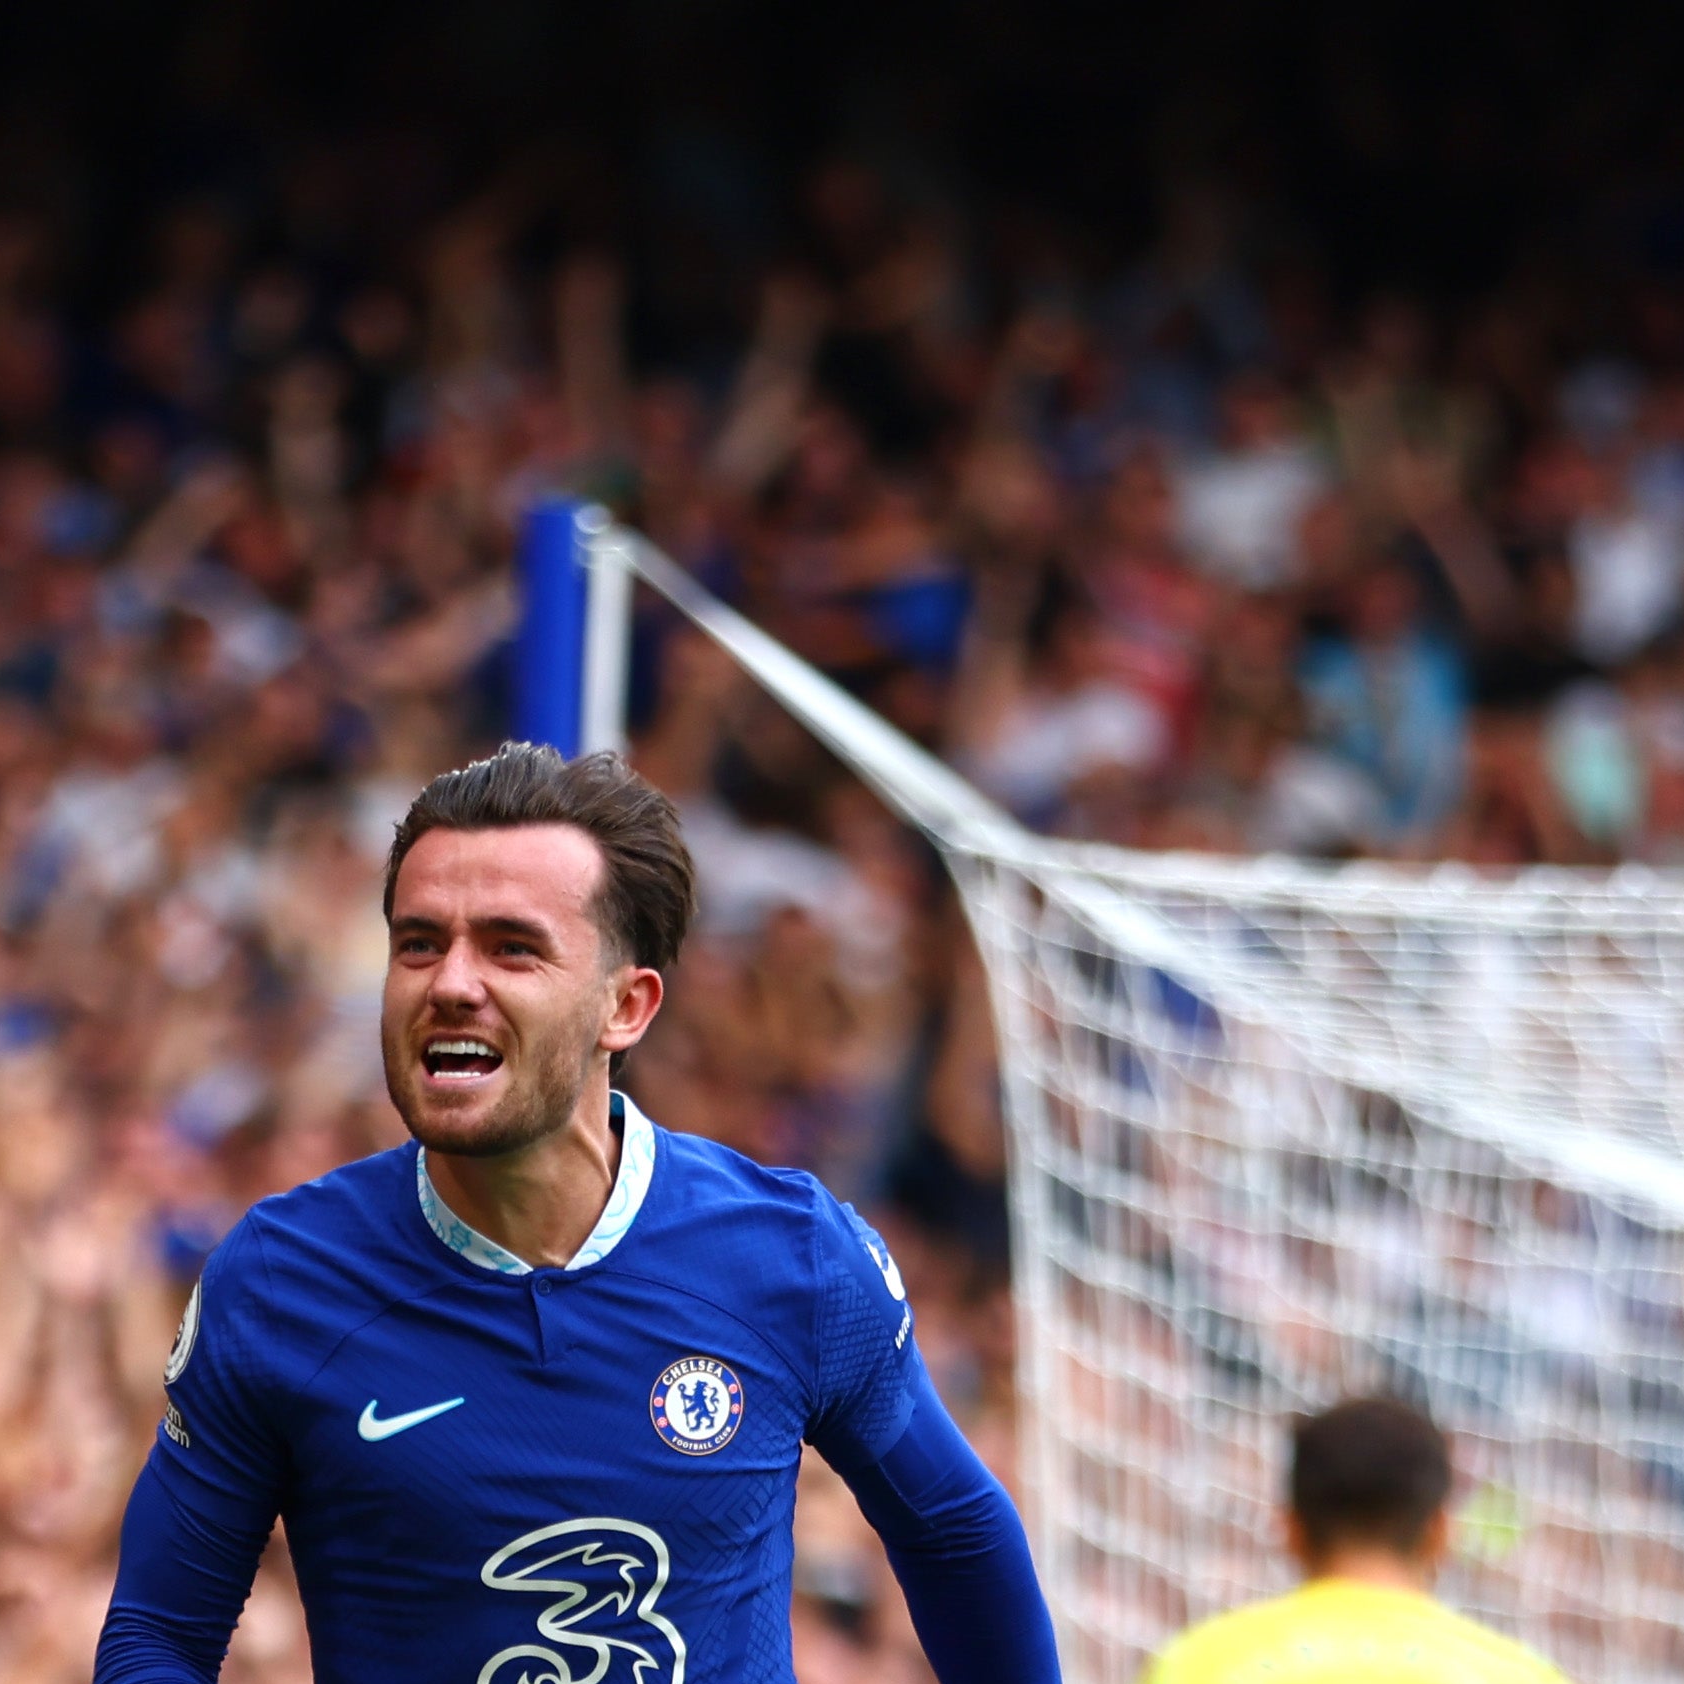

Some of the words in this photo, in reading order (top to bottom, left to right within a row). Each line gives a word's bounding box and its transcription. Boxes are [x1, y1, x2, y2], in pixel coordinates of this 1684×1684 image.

[662, 1360, 723, 1386] CHELSEA
[672, 1436, 713, 1451] FOOTBALL
[715, 1426, 732, 1444] CLUB
